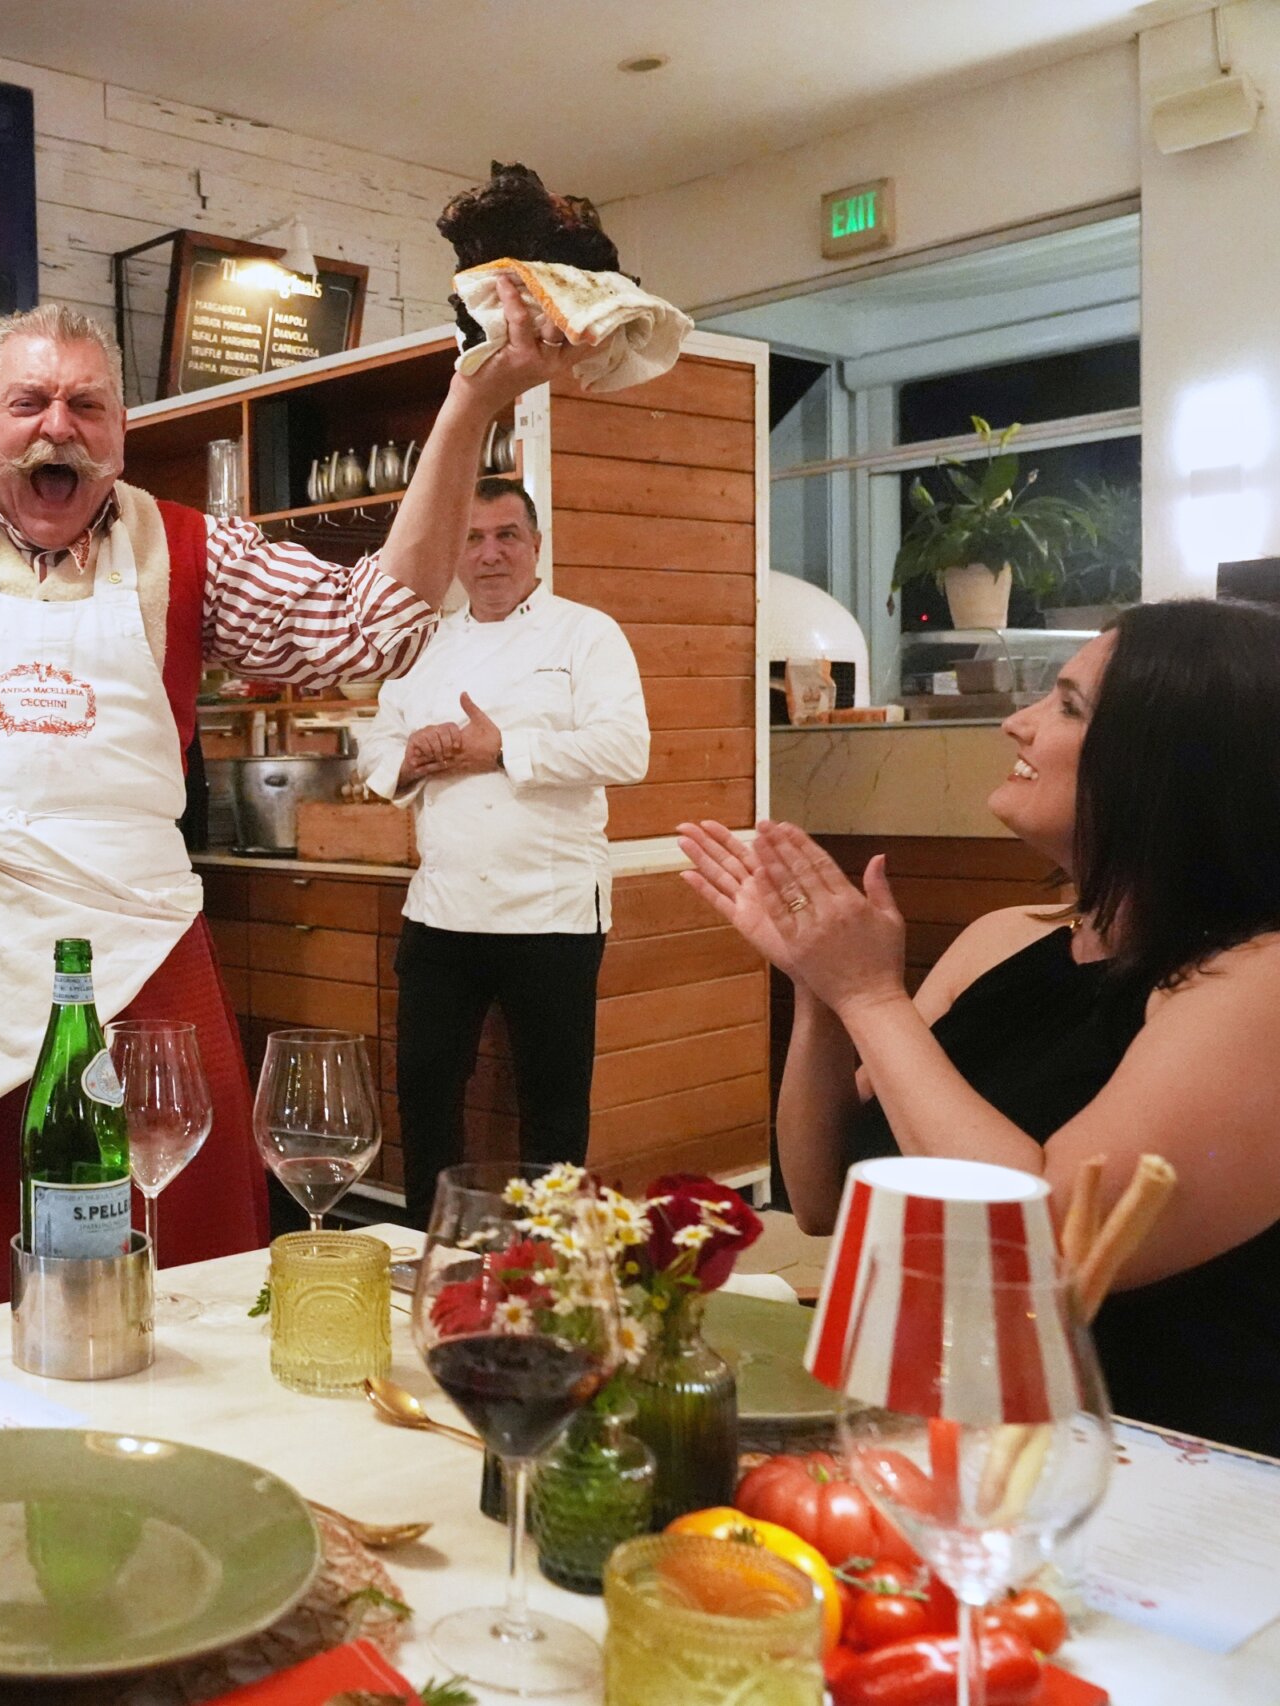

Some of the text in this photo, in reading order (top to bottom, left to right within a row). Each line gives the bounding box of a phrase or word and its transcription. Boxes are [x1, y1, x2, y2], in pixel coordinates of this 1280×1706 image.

[832, 191, 877, 238] EXIT
[274, 313, 308, 328] NAPOLI
[20, 698, 67, 709] CECCHINI
